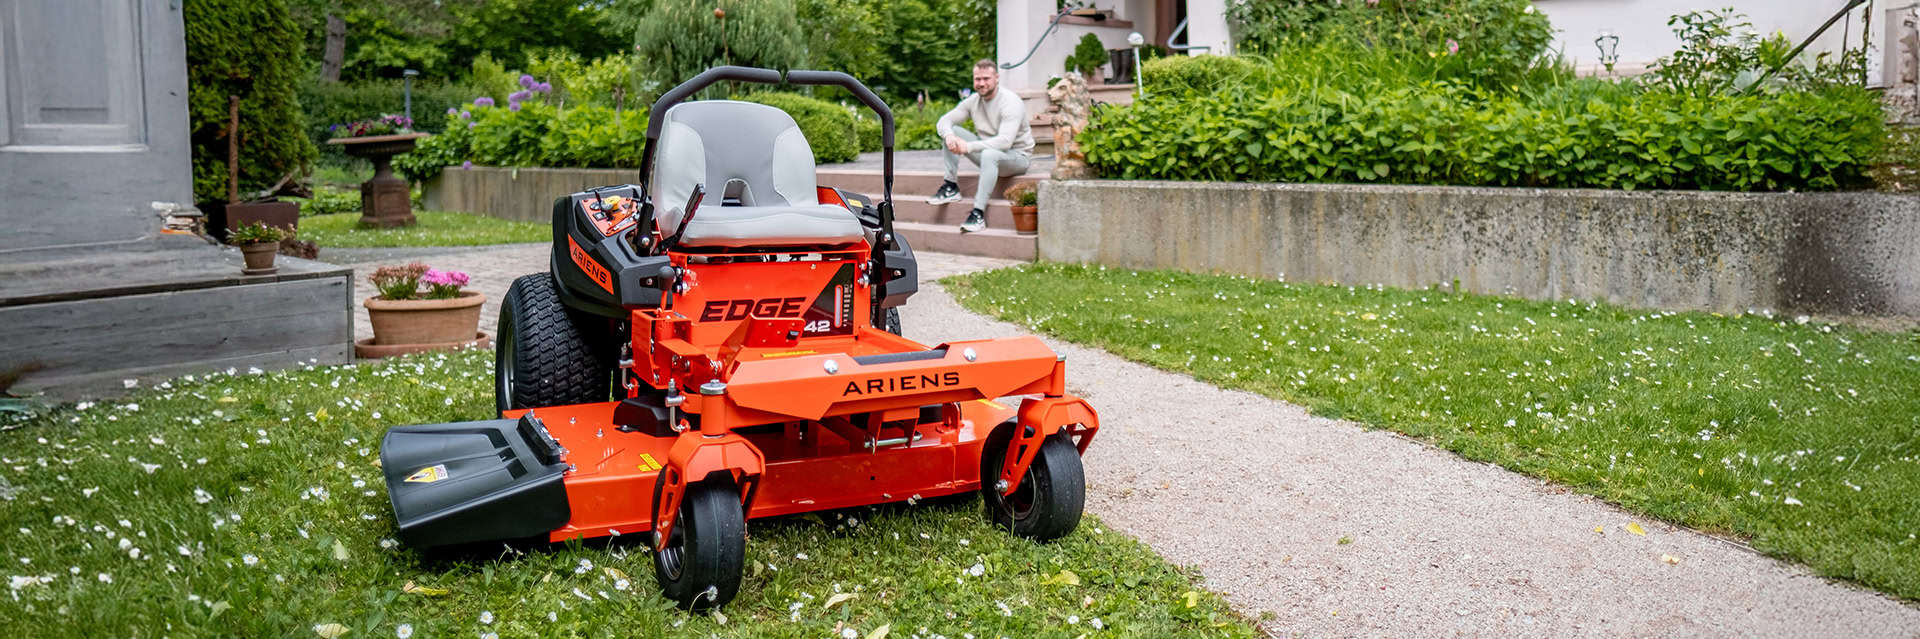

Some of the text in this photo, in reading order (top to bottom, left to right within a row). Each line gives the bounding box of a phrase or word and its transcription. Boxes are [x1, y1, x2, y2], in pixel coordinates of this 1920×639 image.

[573, 247, 607, 284] ARIENS
[699, 297, 807, 322] EDGE
[803, 320, 831, 333] 42
[842, 372, 960, 397] ARIENS
